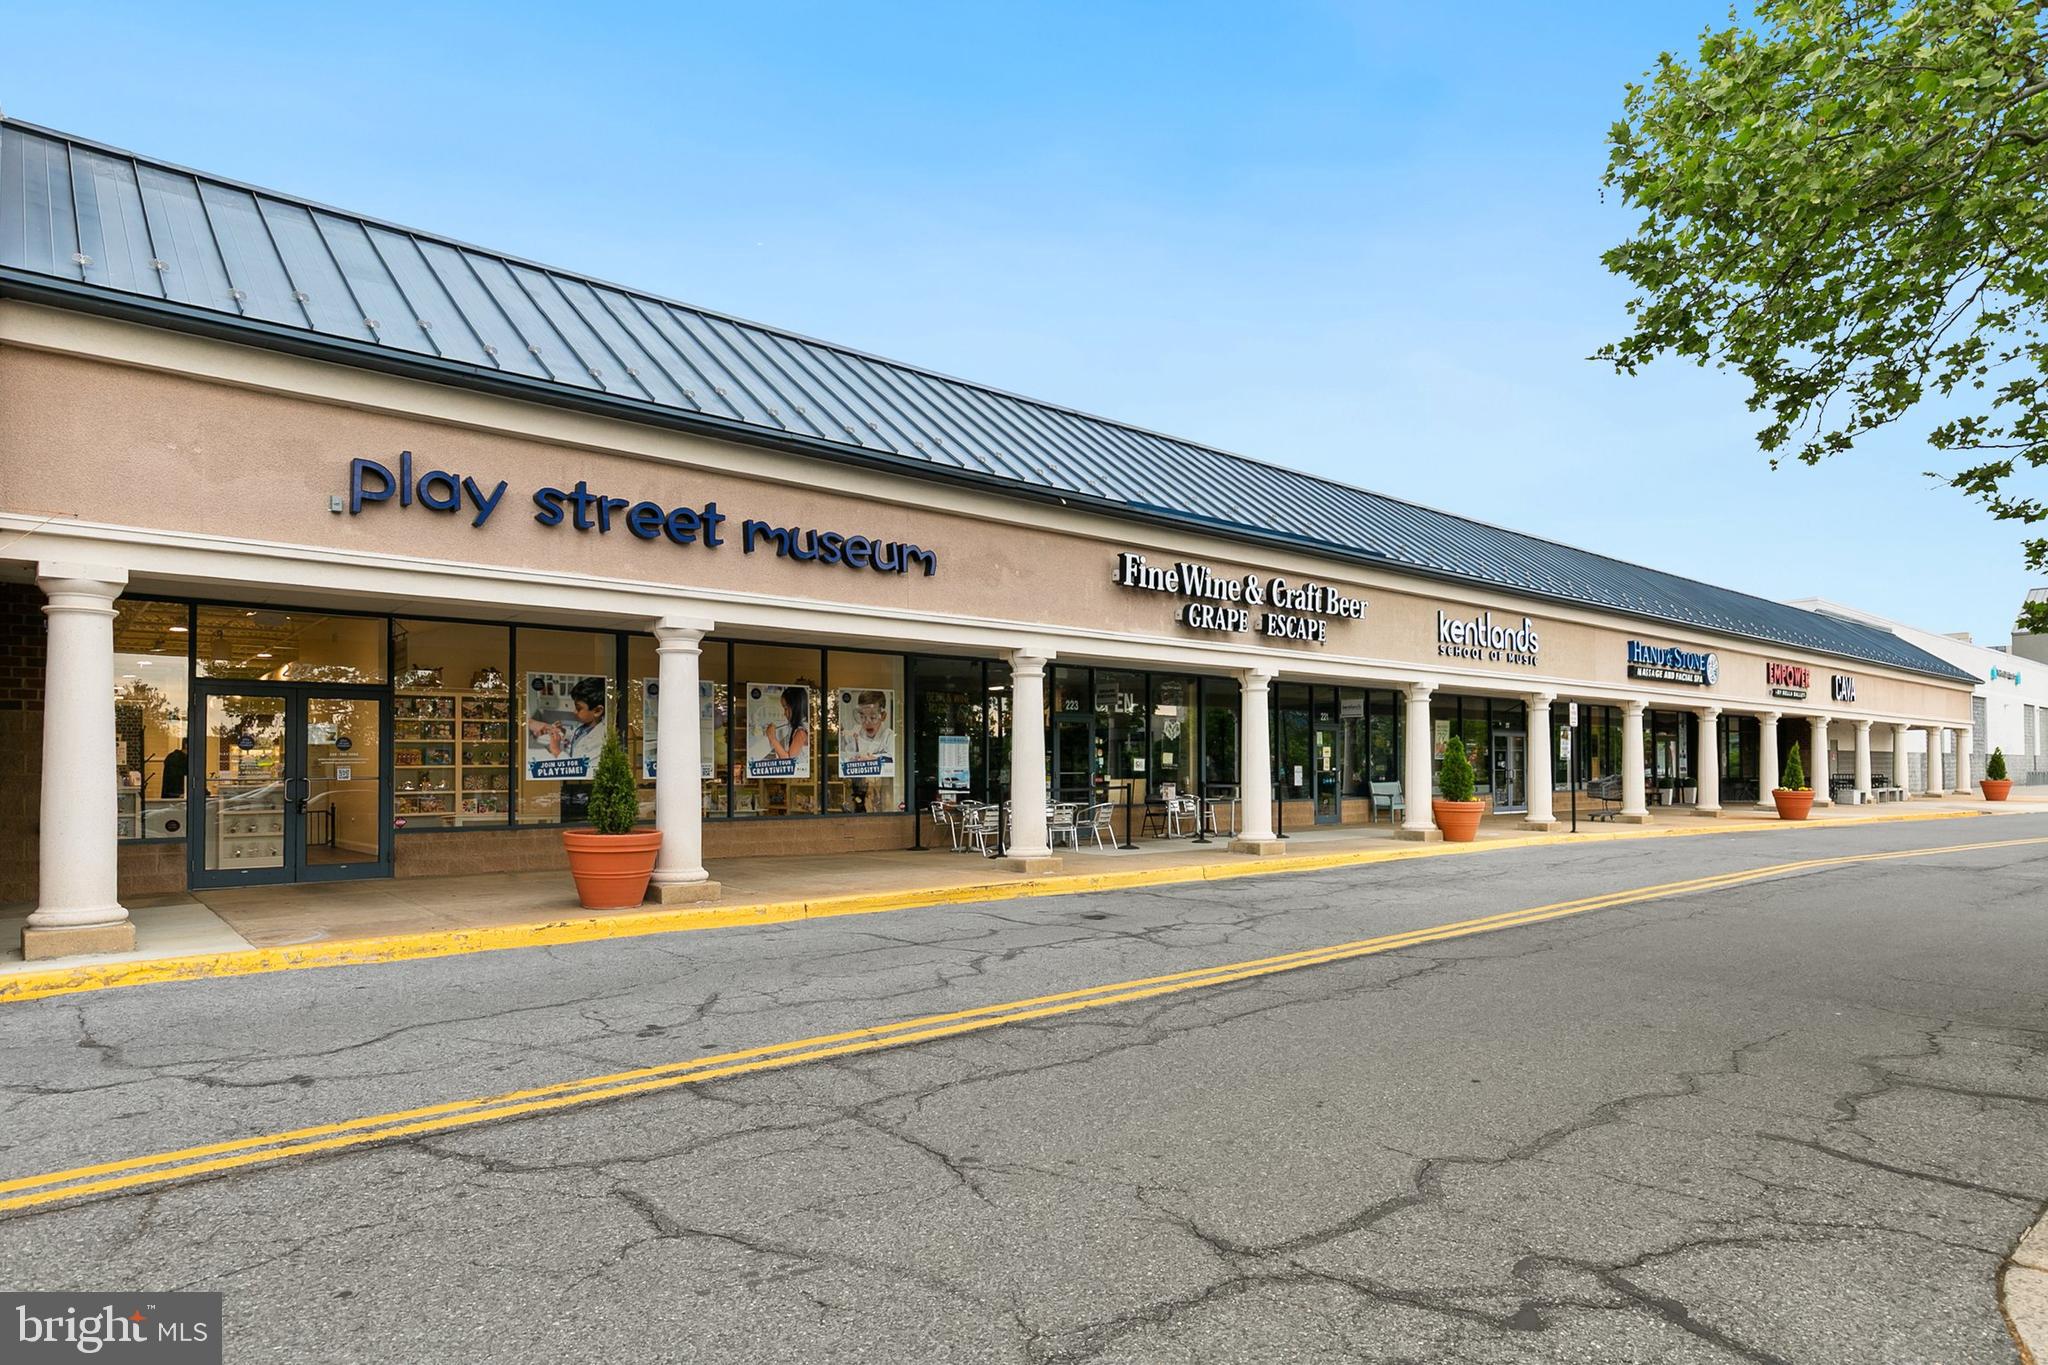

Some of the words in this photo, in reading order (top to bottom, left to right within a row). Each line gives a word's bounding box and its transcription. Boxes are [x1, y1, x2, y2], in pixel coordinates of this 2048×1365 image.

[350, 451, 508, 528] play
[533, 481, 725, 548] street
[743, 519, 938, 577] museum
[1119, 552, 1180, 593] Fine
[1176, 562, 1241, 602] Wine
[1243, 574, 1264, 605] &
[1268, 577, 1322, 612] Craft
[1324, 587, 1369, 619] Beer
[1186, 603, 1249, 633] GRAPE
[1265, 613, 1327, 642] ESCAPE
[1438, 645, 1484, 660] SCHOOL
[1489, 650, 1503, 661] OF
[1507, 652, 1538, 666] MUSIC
[1633, 640, 1665, 665] HAND
[1674, 647, 1706, 671] STONE
[1637, 667, 1663, 679] MASSAGE
[1664, 670, 1675, 680] AND
[1675, 672, 1693, 682] FACIAL
[1694, 675, 1703, 683] SPA
[1768, 663, 1810, 689] EMPOWER
[1834, 675, 1856, 702] CAVA
[1065, 700, 1079, 711] 223
[1320, 712, 1329, 721] 221
[537, 766, 583, 777] PLAYTIME!
[752, 766, 794, 775] CREATIVITY!
